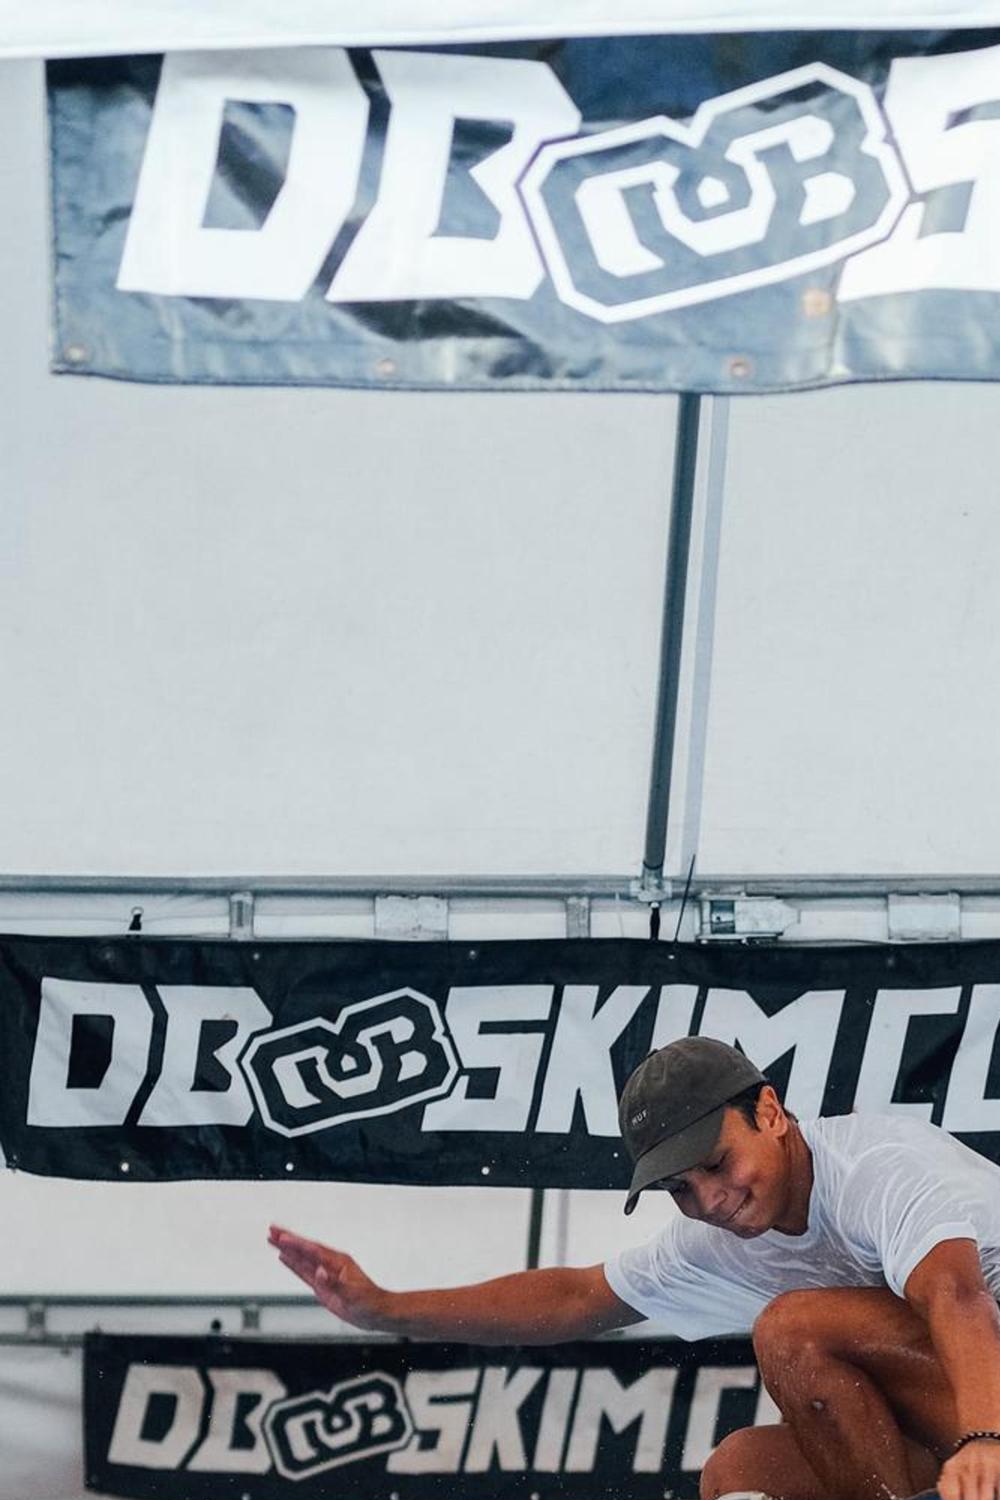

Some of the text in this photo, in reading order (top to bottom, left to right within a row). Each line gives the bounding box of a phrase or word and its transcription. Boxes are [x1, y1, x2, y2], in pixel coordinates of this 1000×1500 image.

[118, 48, 581, 302] DB
[27, 977, 273, 1127] DB
[107, 1364, 288, 1475] DB
[386, 1365, 680, 1475] SKIM
[680, 1365, 784, 1473] C
